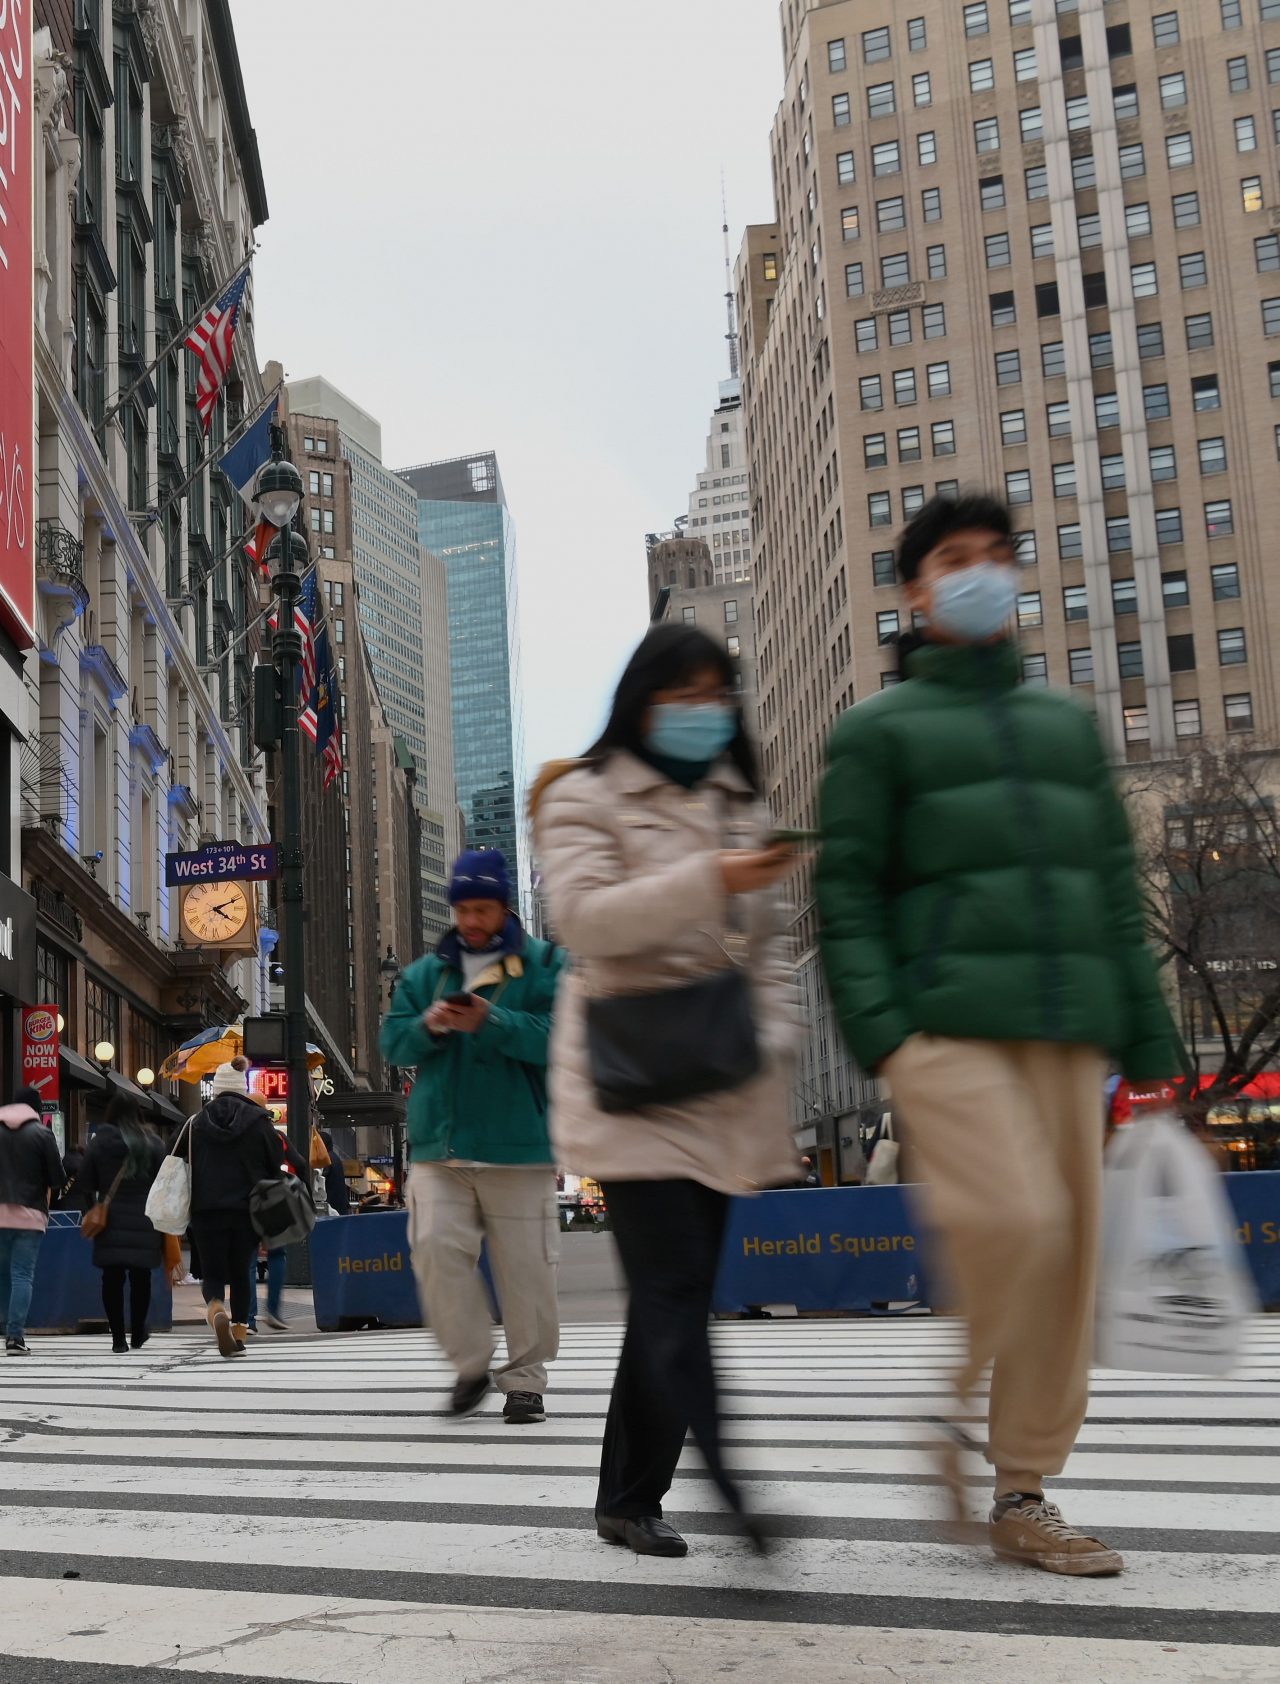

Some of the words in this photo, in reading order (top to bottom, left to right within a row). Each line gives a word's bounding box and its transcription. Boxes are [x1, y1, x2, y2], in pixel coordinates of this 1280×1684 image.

[175, 860, 214, 877] West
[218, 854, 246, 873] 34th
[250, 854, 267, 870] St
[28, 1016, 51, 1028] BURGER
[29, 1021, 53, 1035] KING
[26, 1044, 55, 1056] NOW
[24, 1056, 57, 1068] OPEN
[742, 1233, 821, 1256] Herald
[829, 1233, 916, 1258] Square
[338, 1252, 402, 1274] Herald
